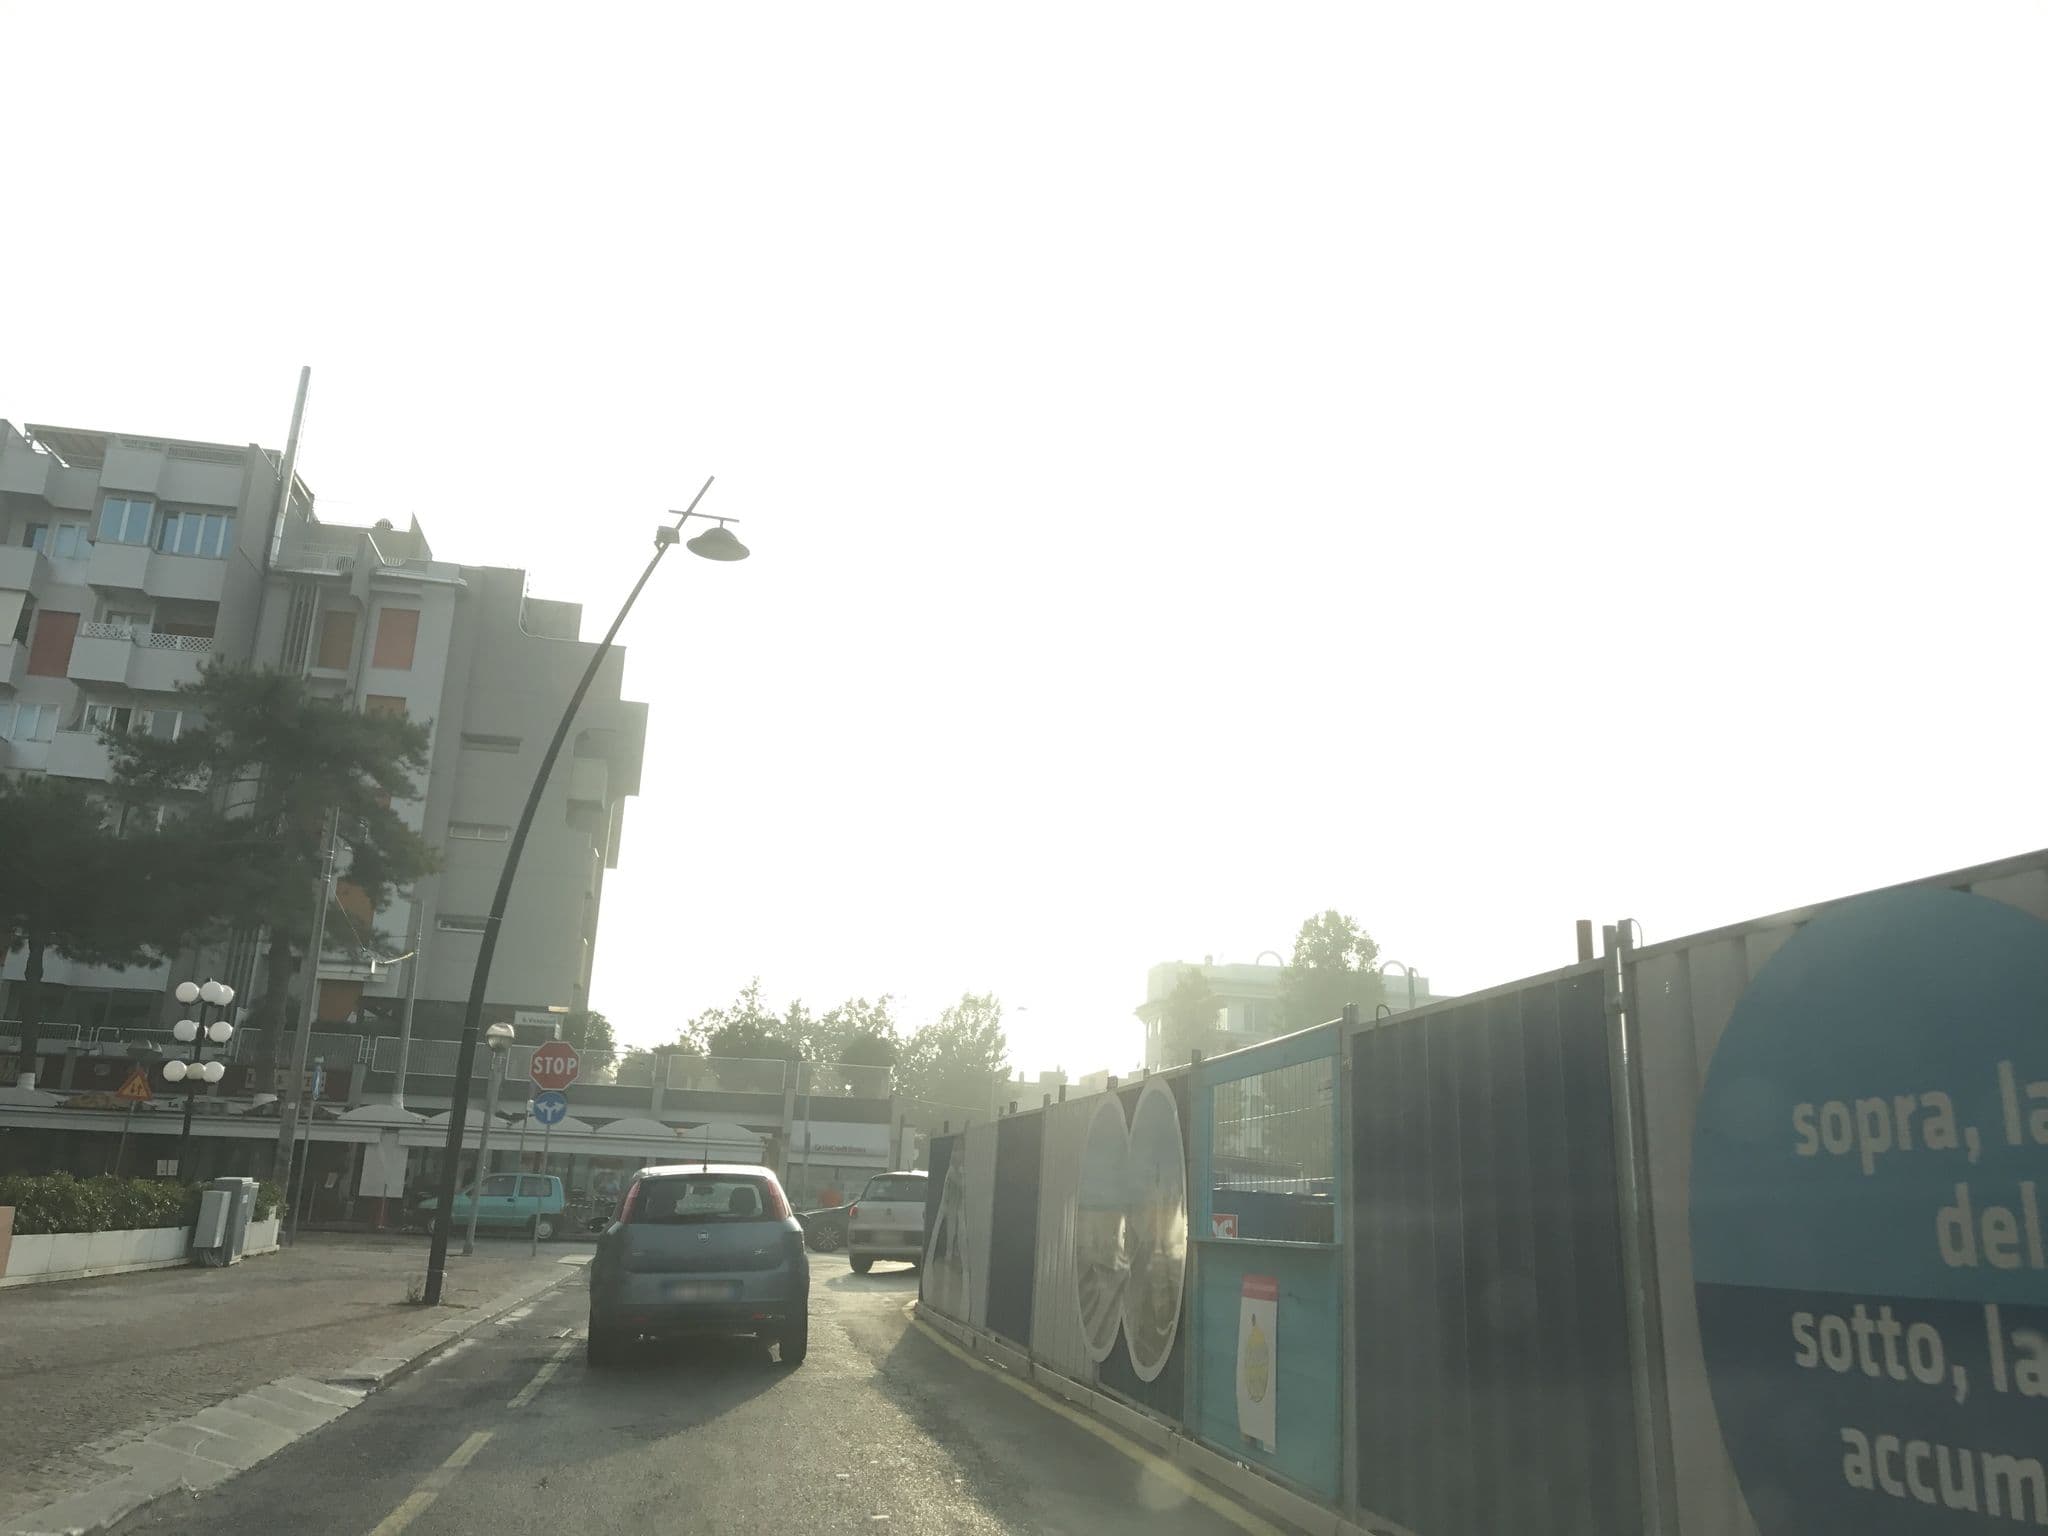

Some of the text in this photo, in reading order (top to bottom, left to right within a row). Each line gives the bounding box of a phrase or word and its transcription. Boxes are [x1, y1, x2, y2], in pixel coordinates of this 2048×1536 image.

[533, 1057, 577, 1075] STOP
[1792, 1091, 1981, 1176] sopra,
[1792, 1304, 2048, 1405] sotto, la
[1840, 1427, 2048, 1526] accum
